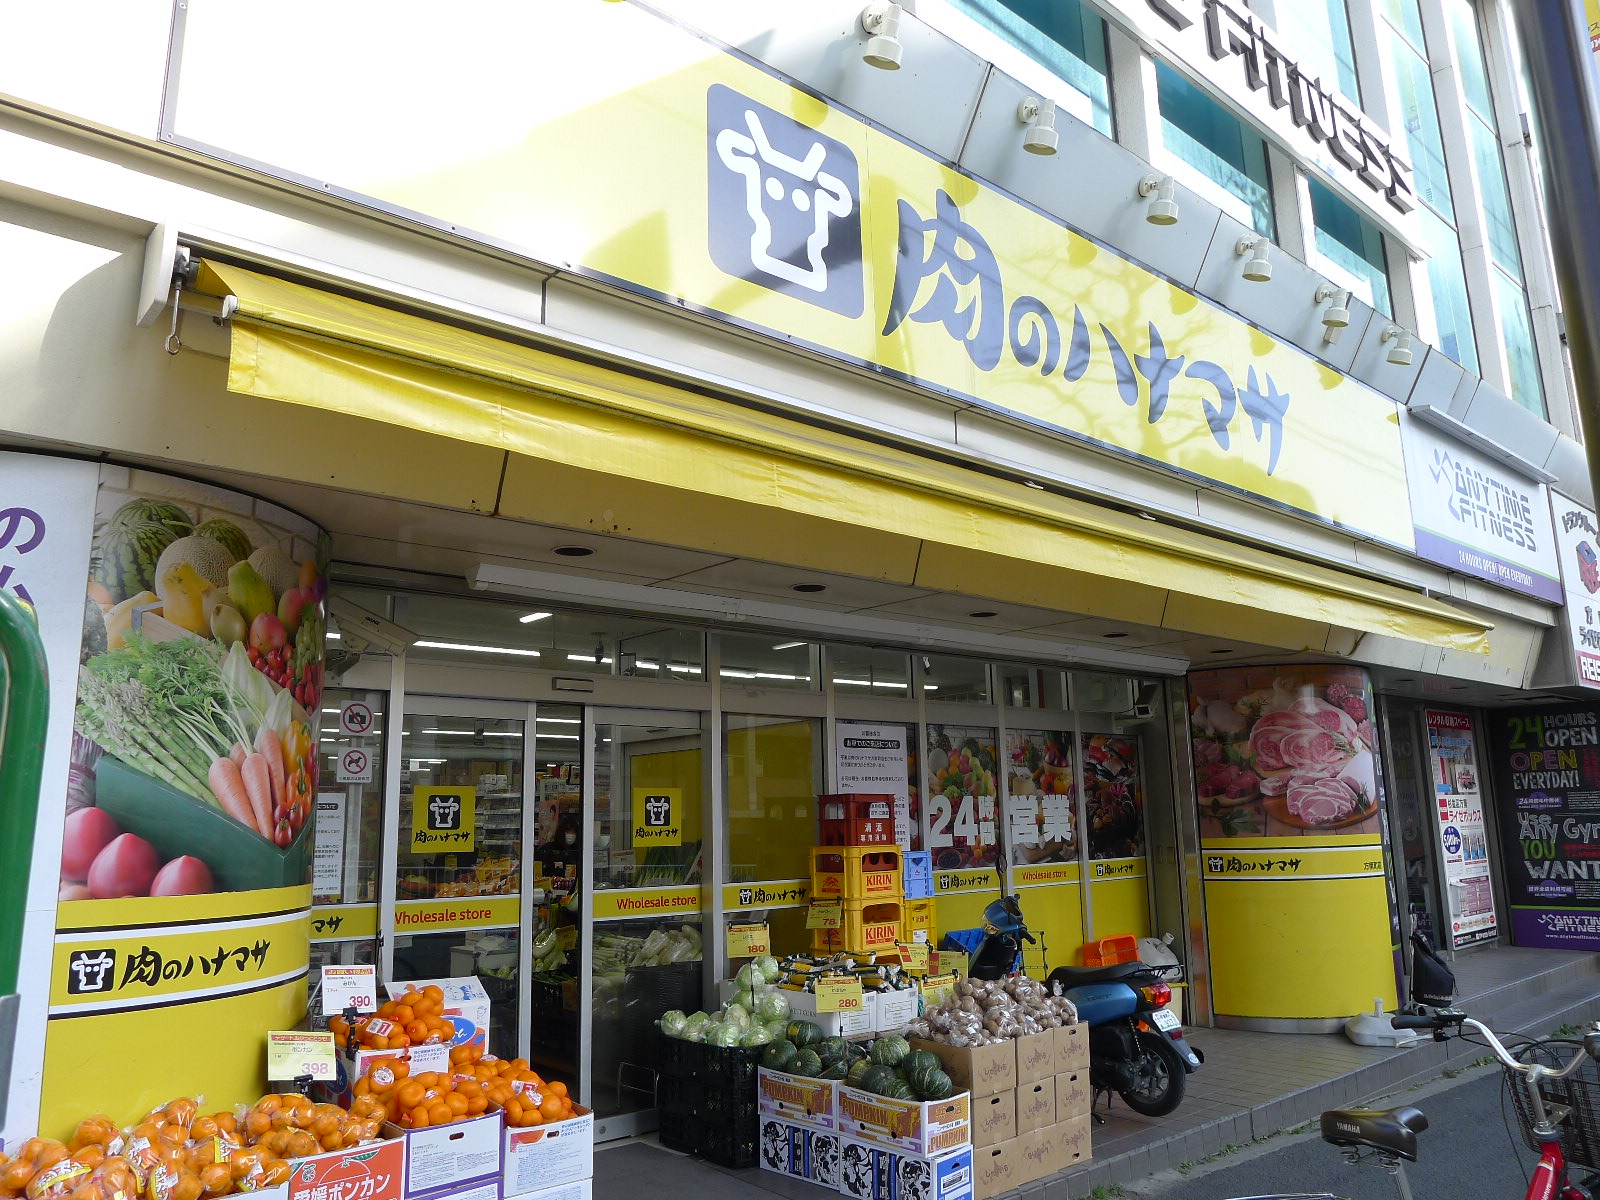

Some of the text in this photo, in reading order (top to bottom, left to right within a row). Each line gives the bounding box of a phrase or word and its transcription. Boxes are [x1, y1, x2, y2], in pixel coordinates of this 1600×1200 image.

[882, 188, 1290, 476] 肉のハナマサ
[1455, 461, 1532, 525] ANYTIME
[1459, 497, 1536, 552] FITNESS
[1507, 712, 1597, 749] 24 HOURS
[1545, 726, 1598, 747] OPEN
[1510, 749, 1577, 771] OPEN
[1513, 770, 1580, 790] EVERYDAY!
[1517, 812, 1551, 825] Use
[413, 830, 471, 844] 肉のハナマサ
[635, 827, 679, 838] 肉のハナマサ
[1520, 820, 1558, 843] Any
[1520, 840, 1556, 860] YOU
[1104, 863, 1134, 875] 肉のハナマサ
[1226, 857, 1302, 873] 肉のハナマサ
[1524, 861, 1600, 879] WANT
[866, 874, 892, 886] KIRIN
[950, 874, 990, 888] 肉のハナマサ
[1021, 870, 1067, 881] Wholesale store
[616, 895, 697, 910] Wholesale store
[754, 887, 807, 904] 肉のハナマサ
[460, 908, 492, 922] store
[823, 918, 836, 926] 78
[311, 916, 343, 934] マサ
[866, 925, 895, 940] KIRIN
[747, 945, 765, 953] 180
[119, 939, 271, 989] 肉のハナマサ
[349, 995, 370, 1008] 390
[838, 999, 857, 1008] 280
[302, 1062, 329, 1075] 398
[763, 1079, 804, 1105] PUMPKIN
[842, 1097, 889, 1126] PUMPKIN
[1336, 1122, 1361, 1134] YAMAHA
[929, 1128, 967, 1151] PUMPKIN
